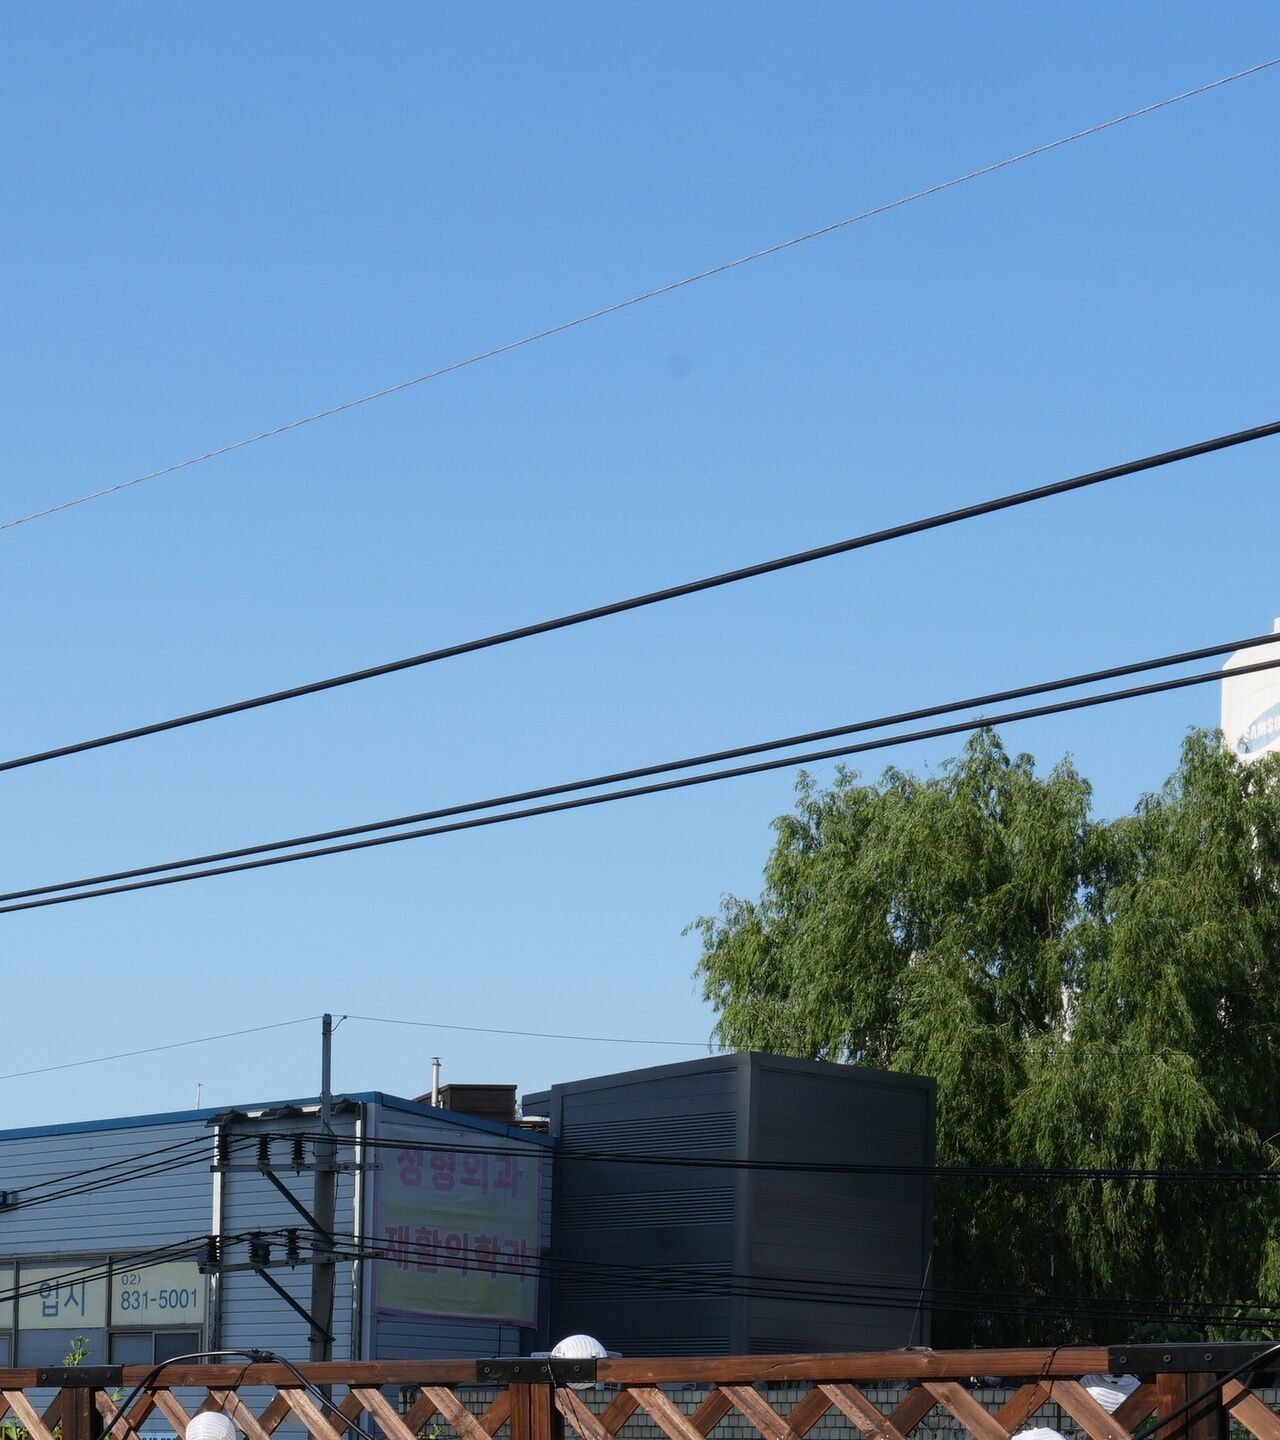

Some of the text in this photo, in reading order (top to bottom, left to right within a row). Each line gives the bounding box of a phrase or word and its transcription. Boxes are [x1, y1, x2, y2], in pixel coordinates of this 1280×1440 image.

[396, 1148, 523, 1198] 성형외과
[121, 1273, 141, 1285] 02)
[40, 1279, 86, 1316] 입시
[121, 1288, 198, 1310] 831-5001
